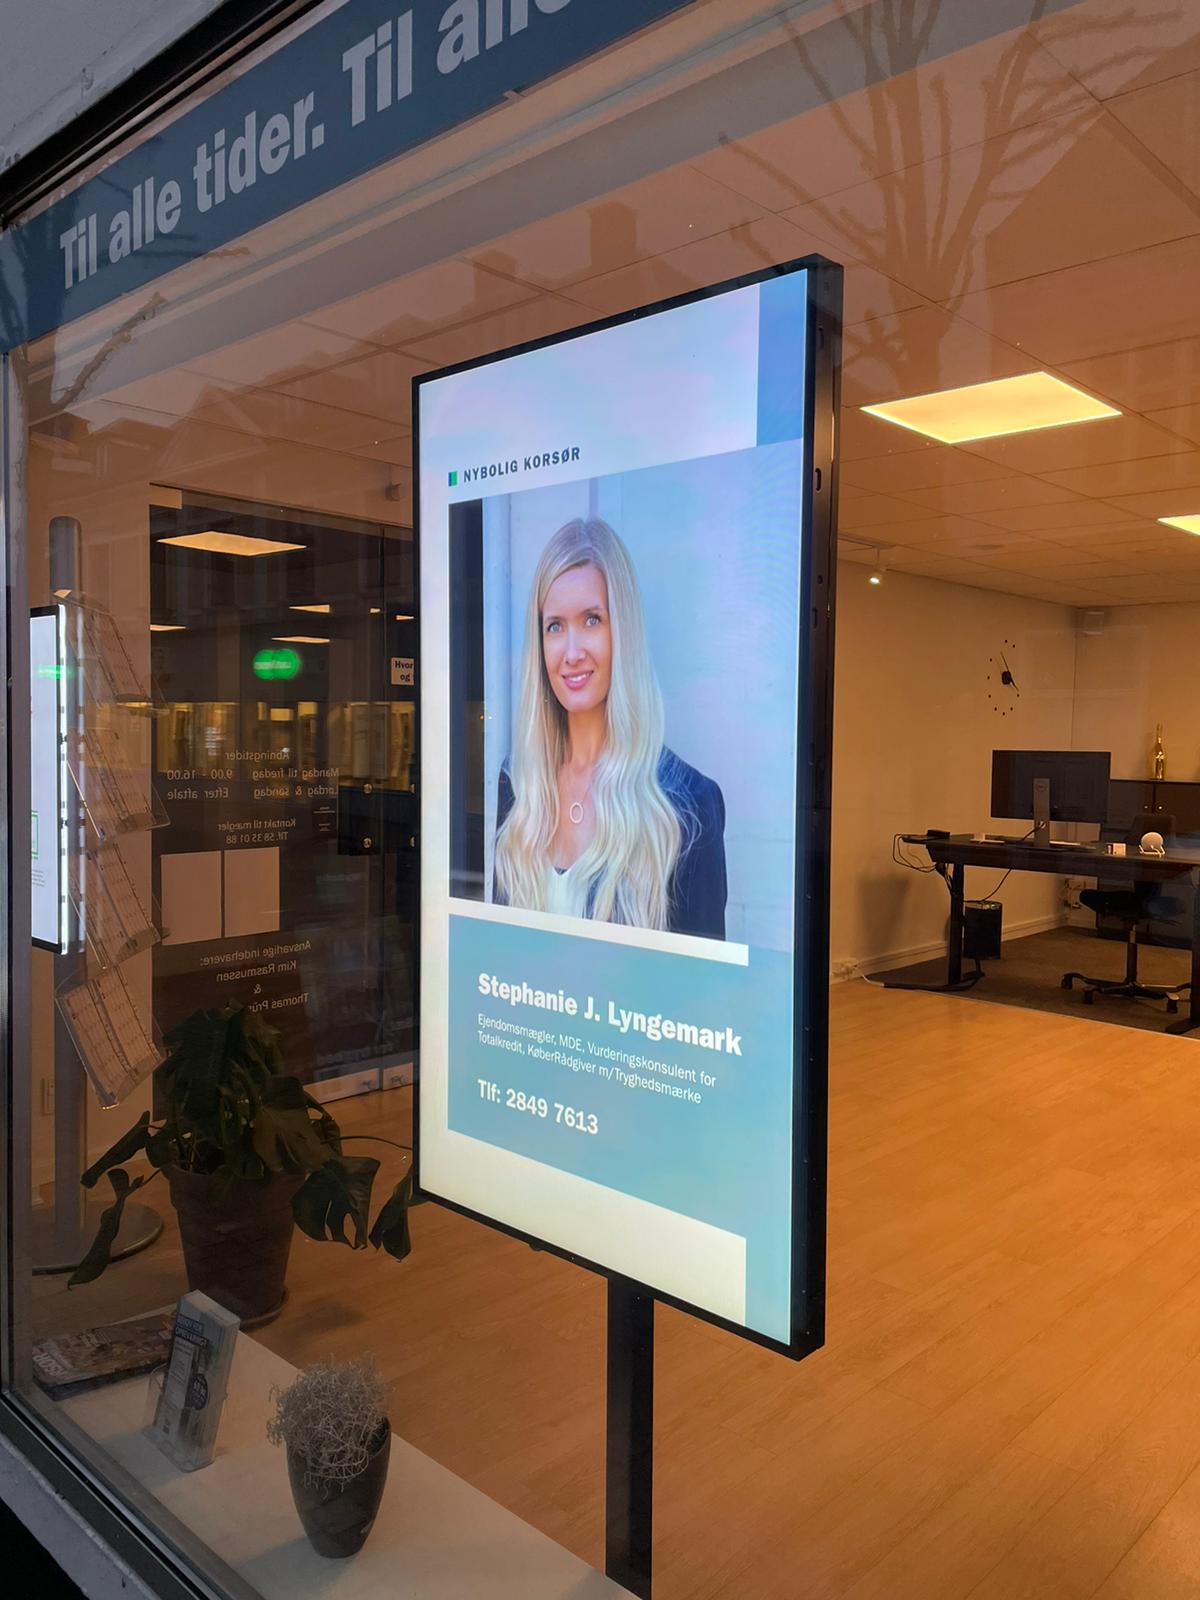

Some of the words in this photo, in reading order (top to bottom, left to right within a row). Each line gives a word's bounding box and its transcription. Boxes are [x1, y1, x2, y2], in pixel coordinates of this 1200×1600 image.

[60, 213, 97, 290] Til
[108, 176, 182, 263] alle
[193, 91, 325, 213] tider.
[342, 8, 413, 127] Til
[436, 0, 573, 74] al
[463, 460, 518, 483] NYBOLIG
[523, 446, 580, 471] KORSØR
[477, 1013, 557, 1046] Ejendomsmægler,
[588, 1042, 697, 1083] Vurderingskonsulent
[699, 1070, 717, 1088] for
[478, 972, 578, 1016] Stephanie
[583, 996, 601, 1022] J.
[608, 1000, 743, 1057] Lyngemark
[477, 1030, 525, 1055] Totalkredit,
[527, 1044, 597, 1072] KøberRådgiver
[598, 1064, 701, 1104] m/Tryghedsmærke
[477, 1079, 501, 1103] Tlf:
[506, 1088, 549, 1118] 2849
[554, 1102, 599, 1135] 7613
